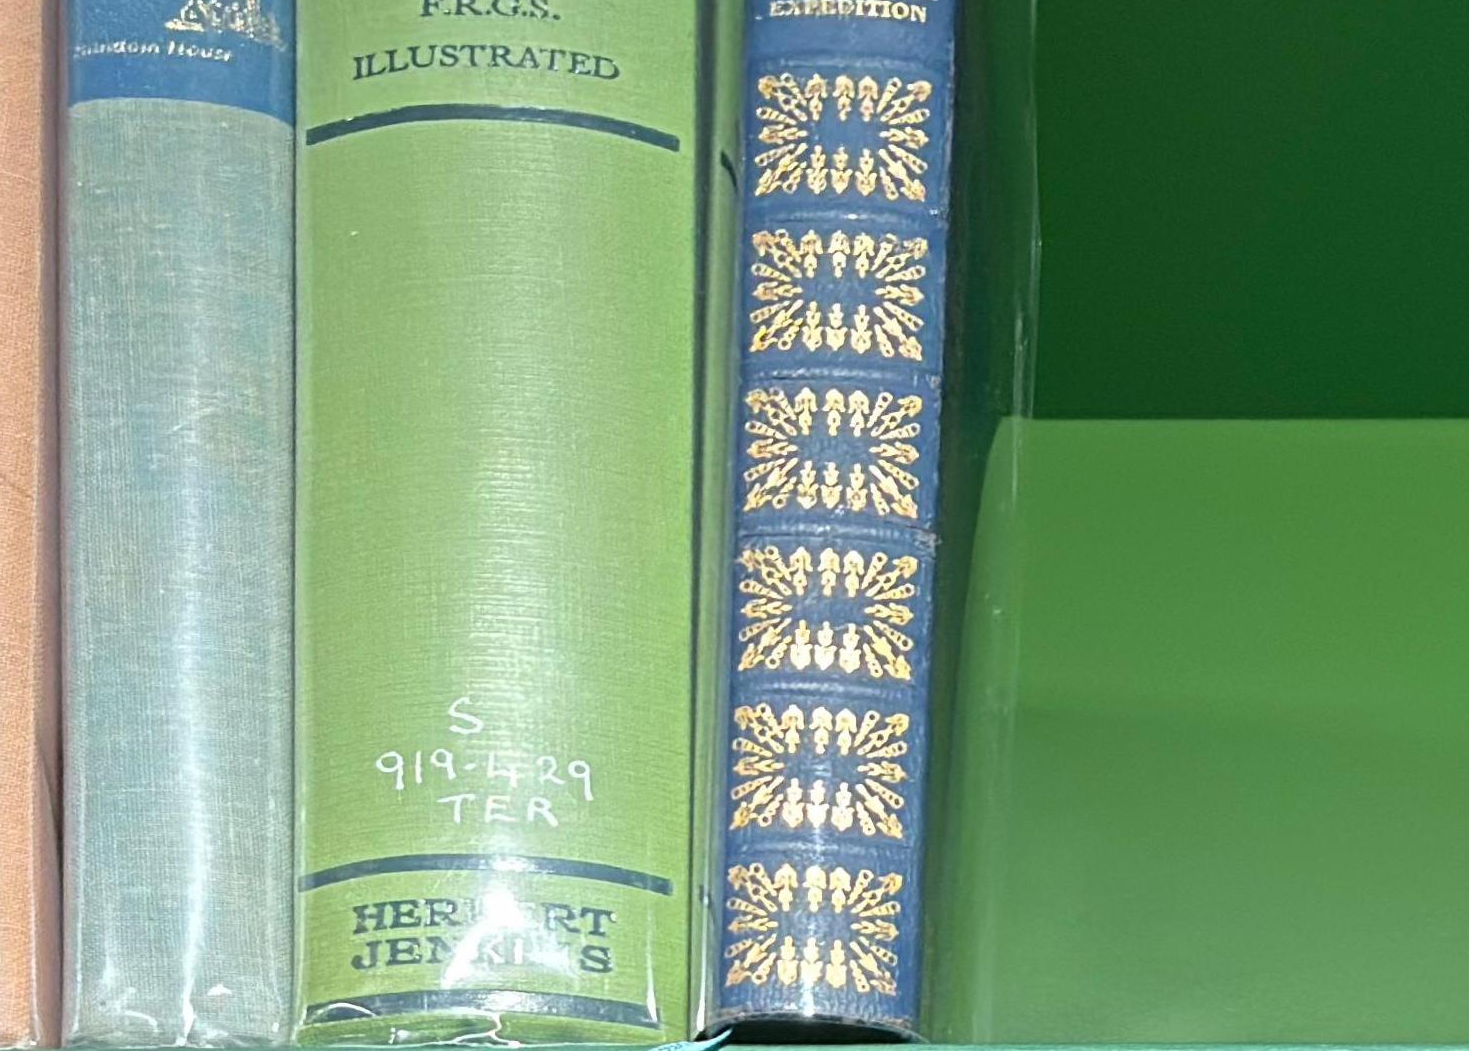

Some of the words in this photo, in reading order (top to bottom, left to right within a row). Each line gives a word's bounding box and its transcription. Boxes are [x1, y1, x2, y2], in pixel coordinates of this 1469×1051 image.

[352, 44, 621, 82] ILLUSTRATED
[447, 696, 484, 736] S
[437, 792, 559, 828] TER
